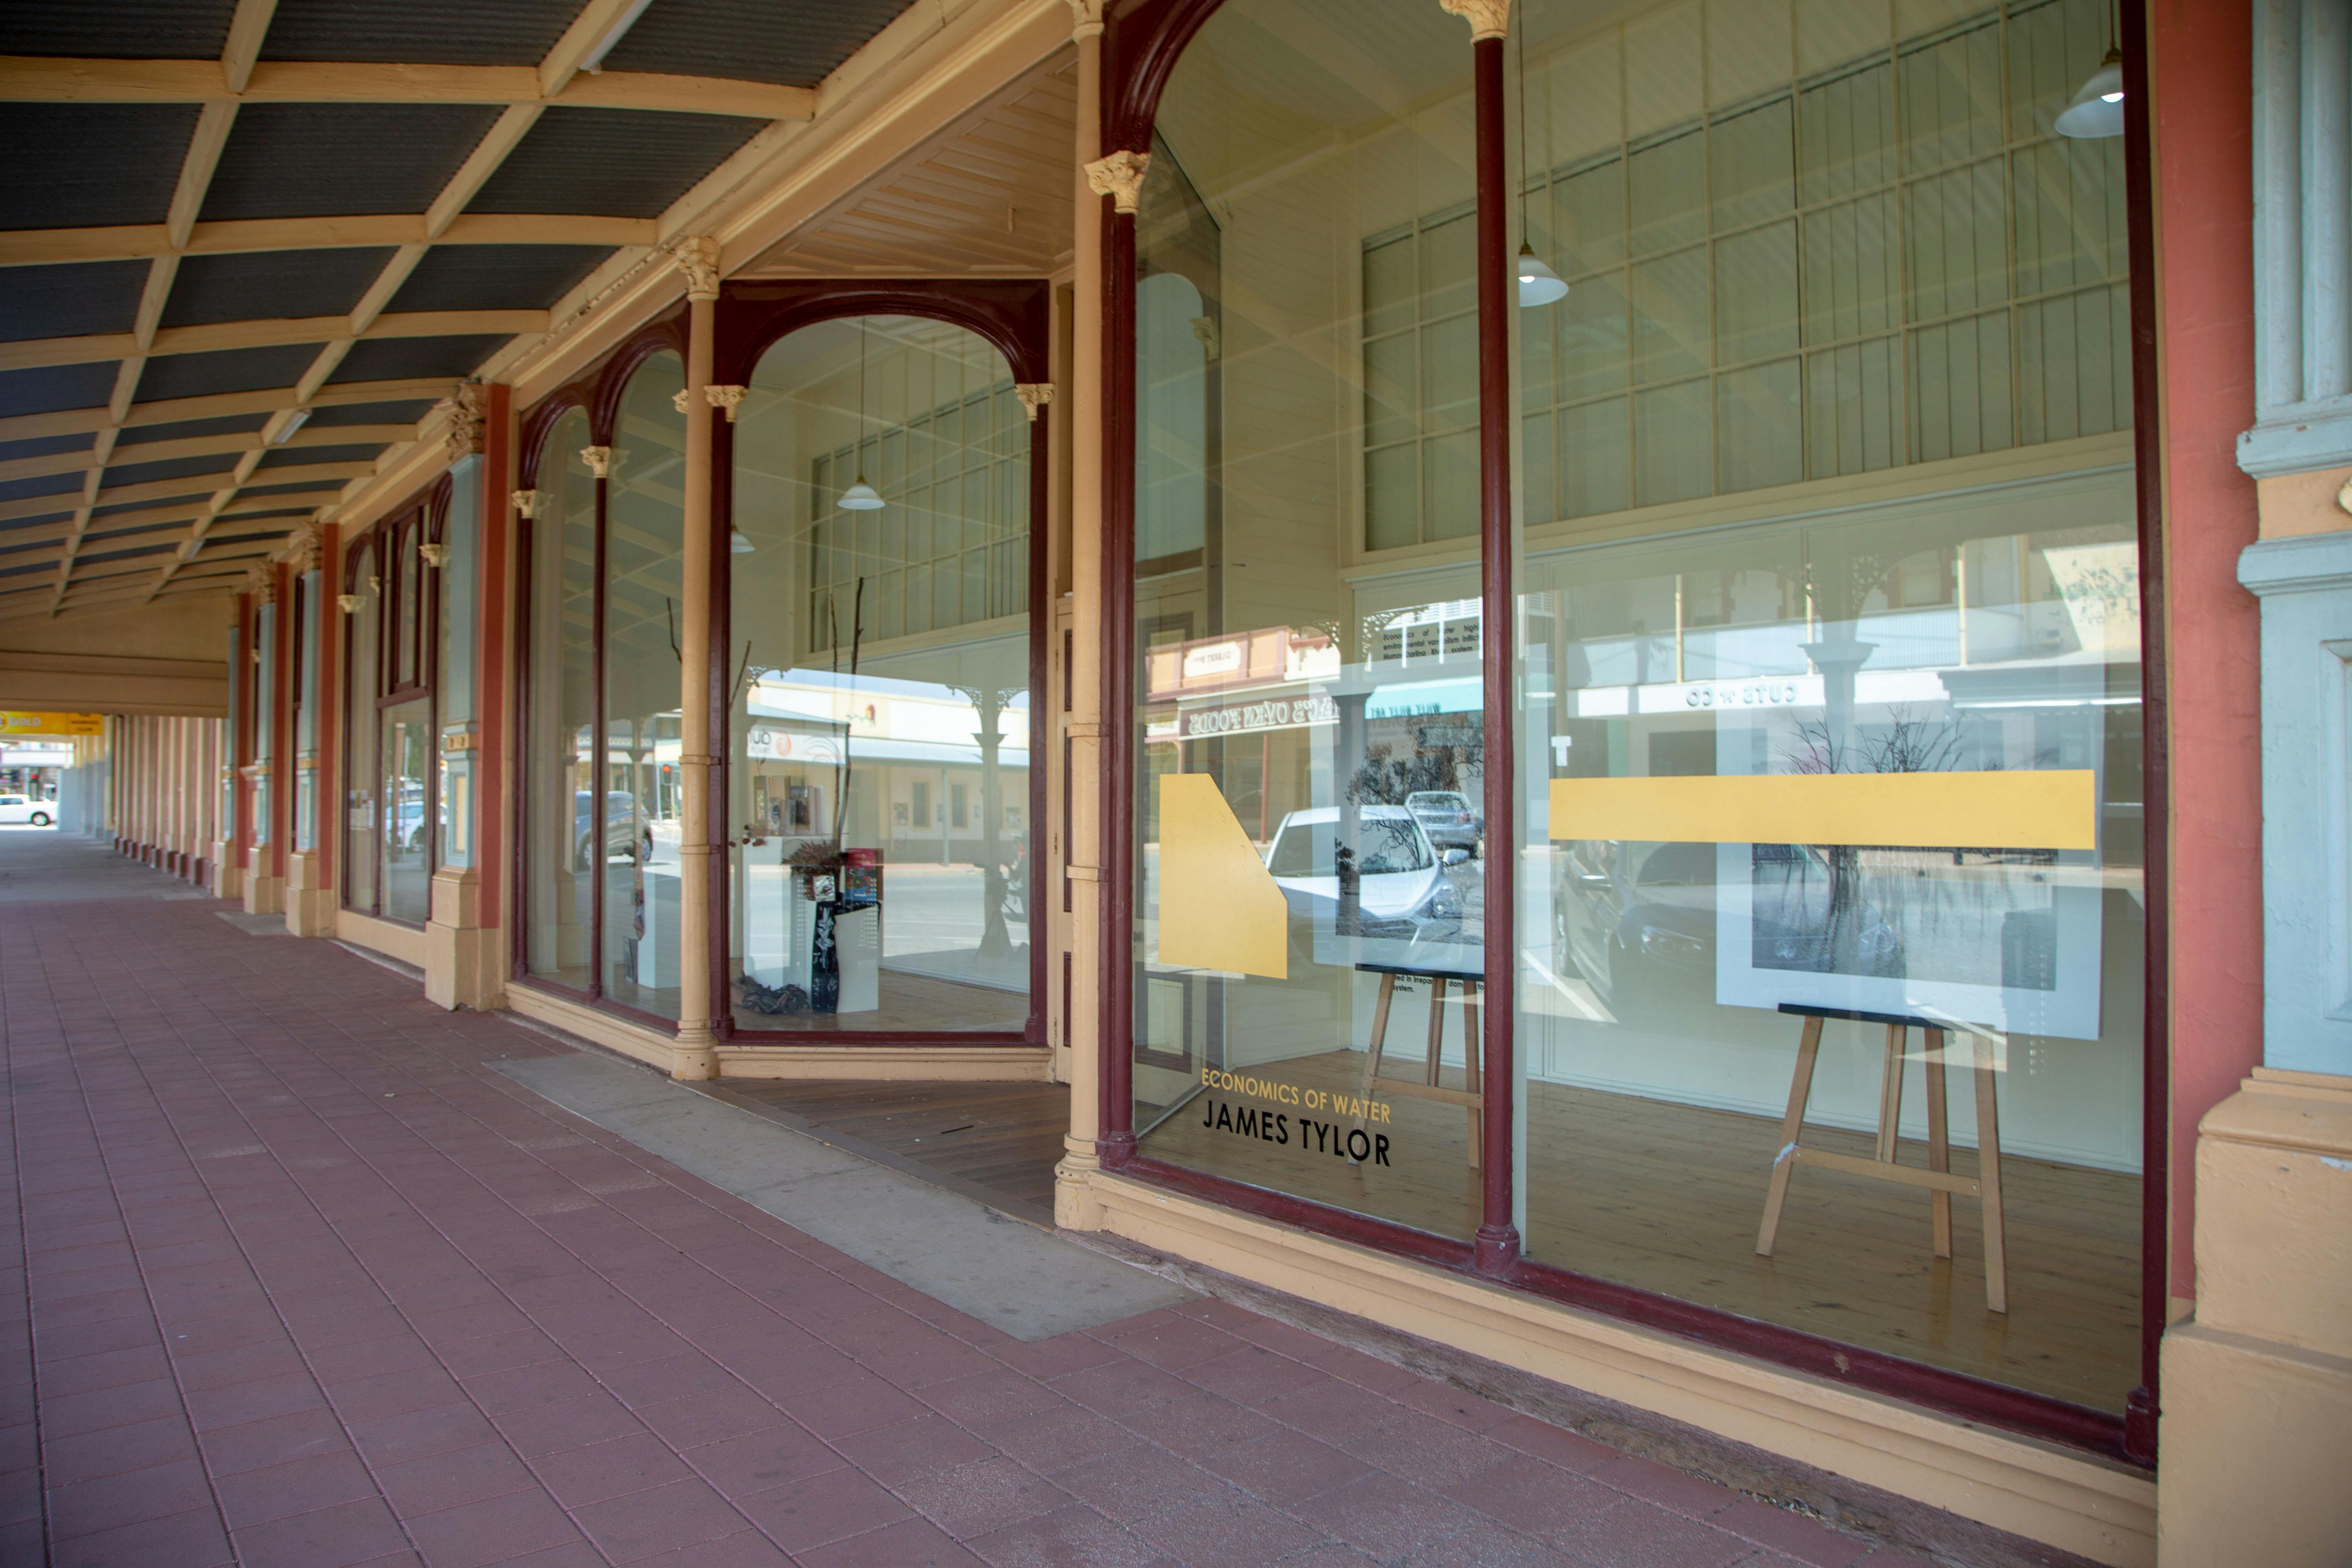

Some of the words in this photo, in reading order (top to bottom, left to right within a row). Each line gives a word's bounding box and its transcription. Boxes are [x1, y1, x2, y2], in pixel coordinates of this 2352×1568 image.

[9, 716, 42, 727] GOLD
[1201, 1067, 1300, 1105] ECONOMICS
[1304, 1089, 1327, 1111] OF
[1332, 1093, 1391, 1124] WATER
[1203, 1099, 1289, 1145] JAMES
[1299, 1118, 1391, 1167] TYLOR
